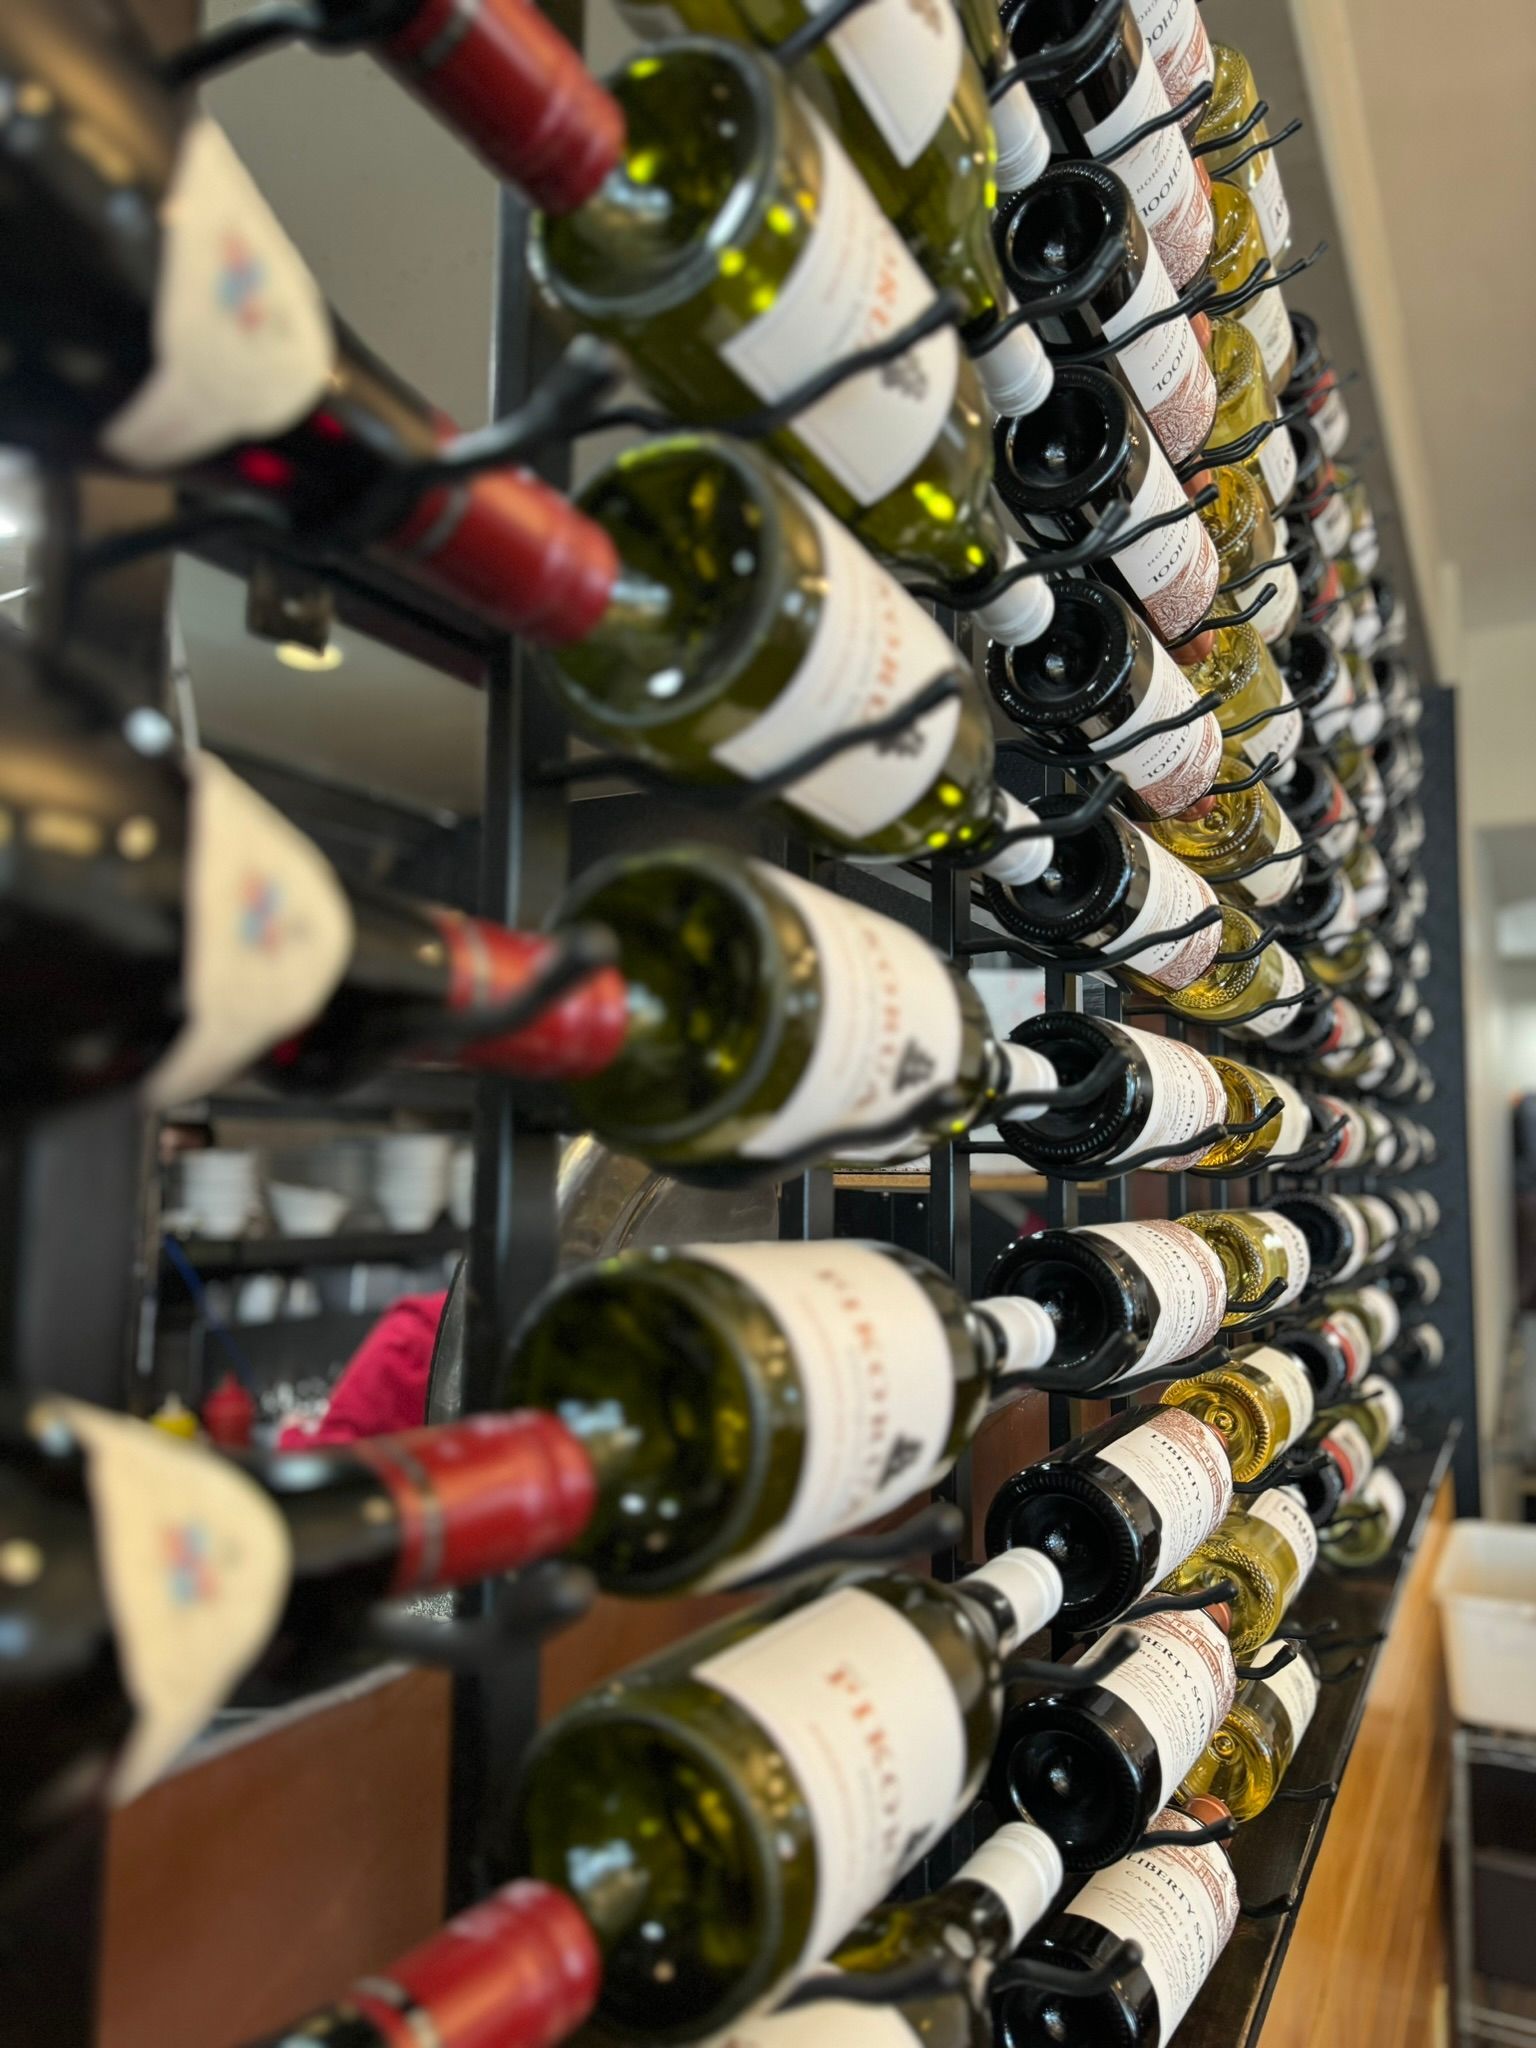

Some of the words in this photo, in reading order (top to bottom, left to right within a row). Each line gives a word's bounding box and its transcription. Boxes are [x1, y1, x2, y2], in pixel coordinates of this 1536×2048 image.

[1147, 519, 1189, 583] CHOOL
[1142, 724, 1190, 778] CHOOL
[1151, 1434, 1201, 1501] LIBERTY
[1139, 1649, 1180, 1688] BERNET
[1141, 1634, 1192, 1681] BERTY
[1125, 1870, 1183, 1926] CABERNET
[1126, 1854, 1195, 1915] LIBERTY
